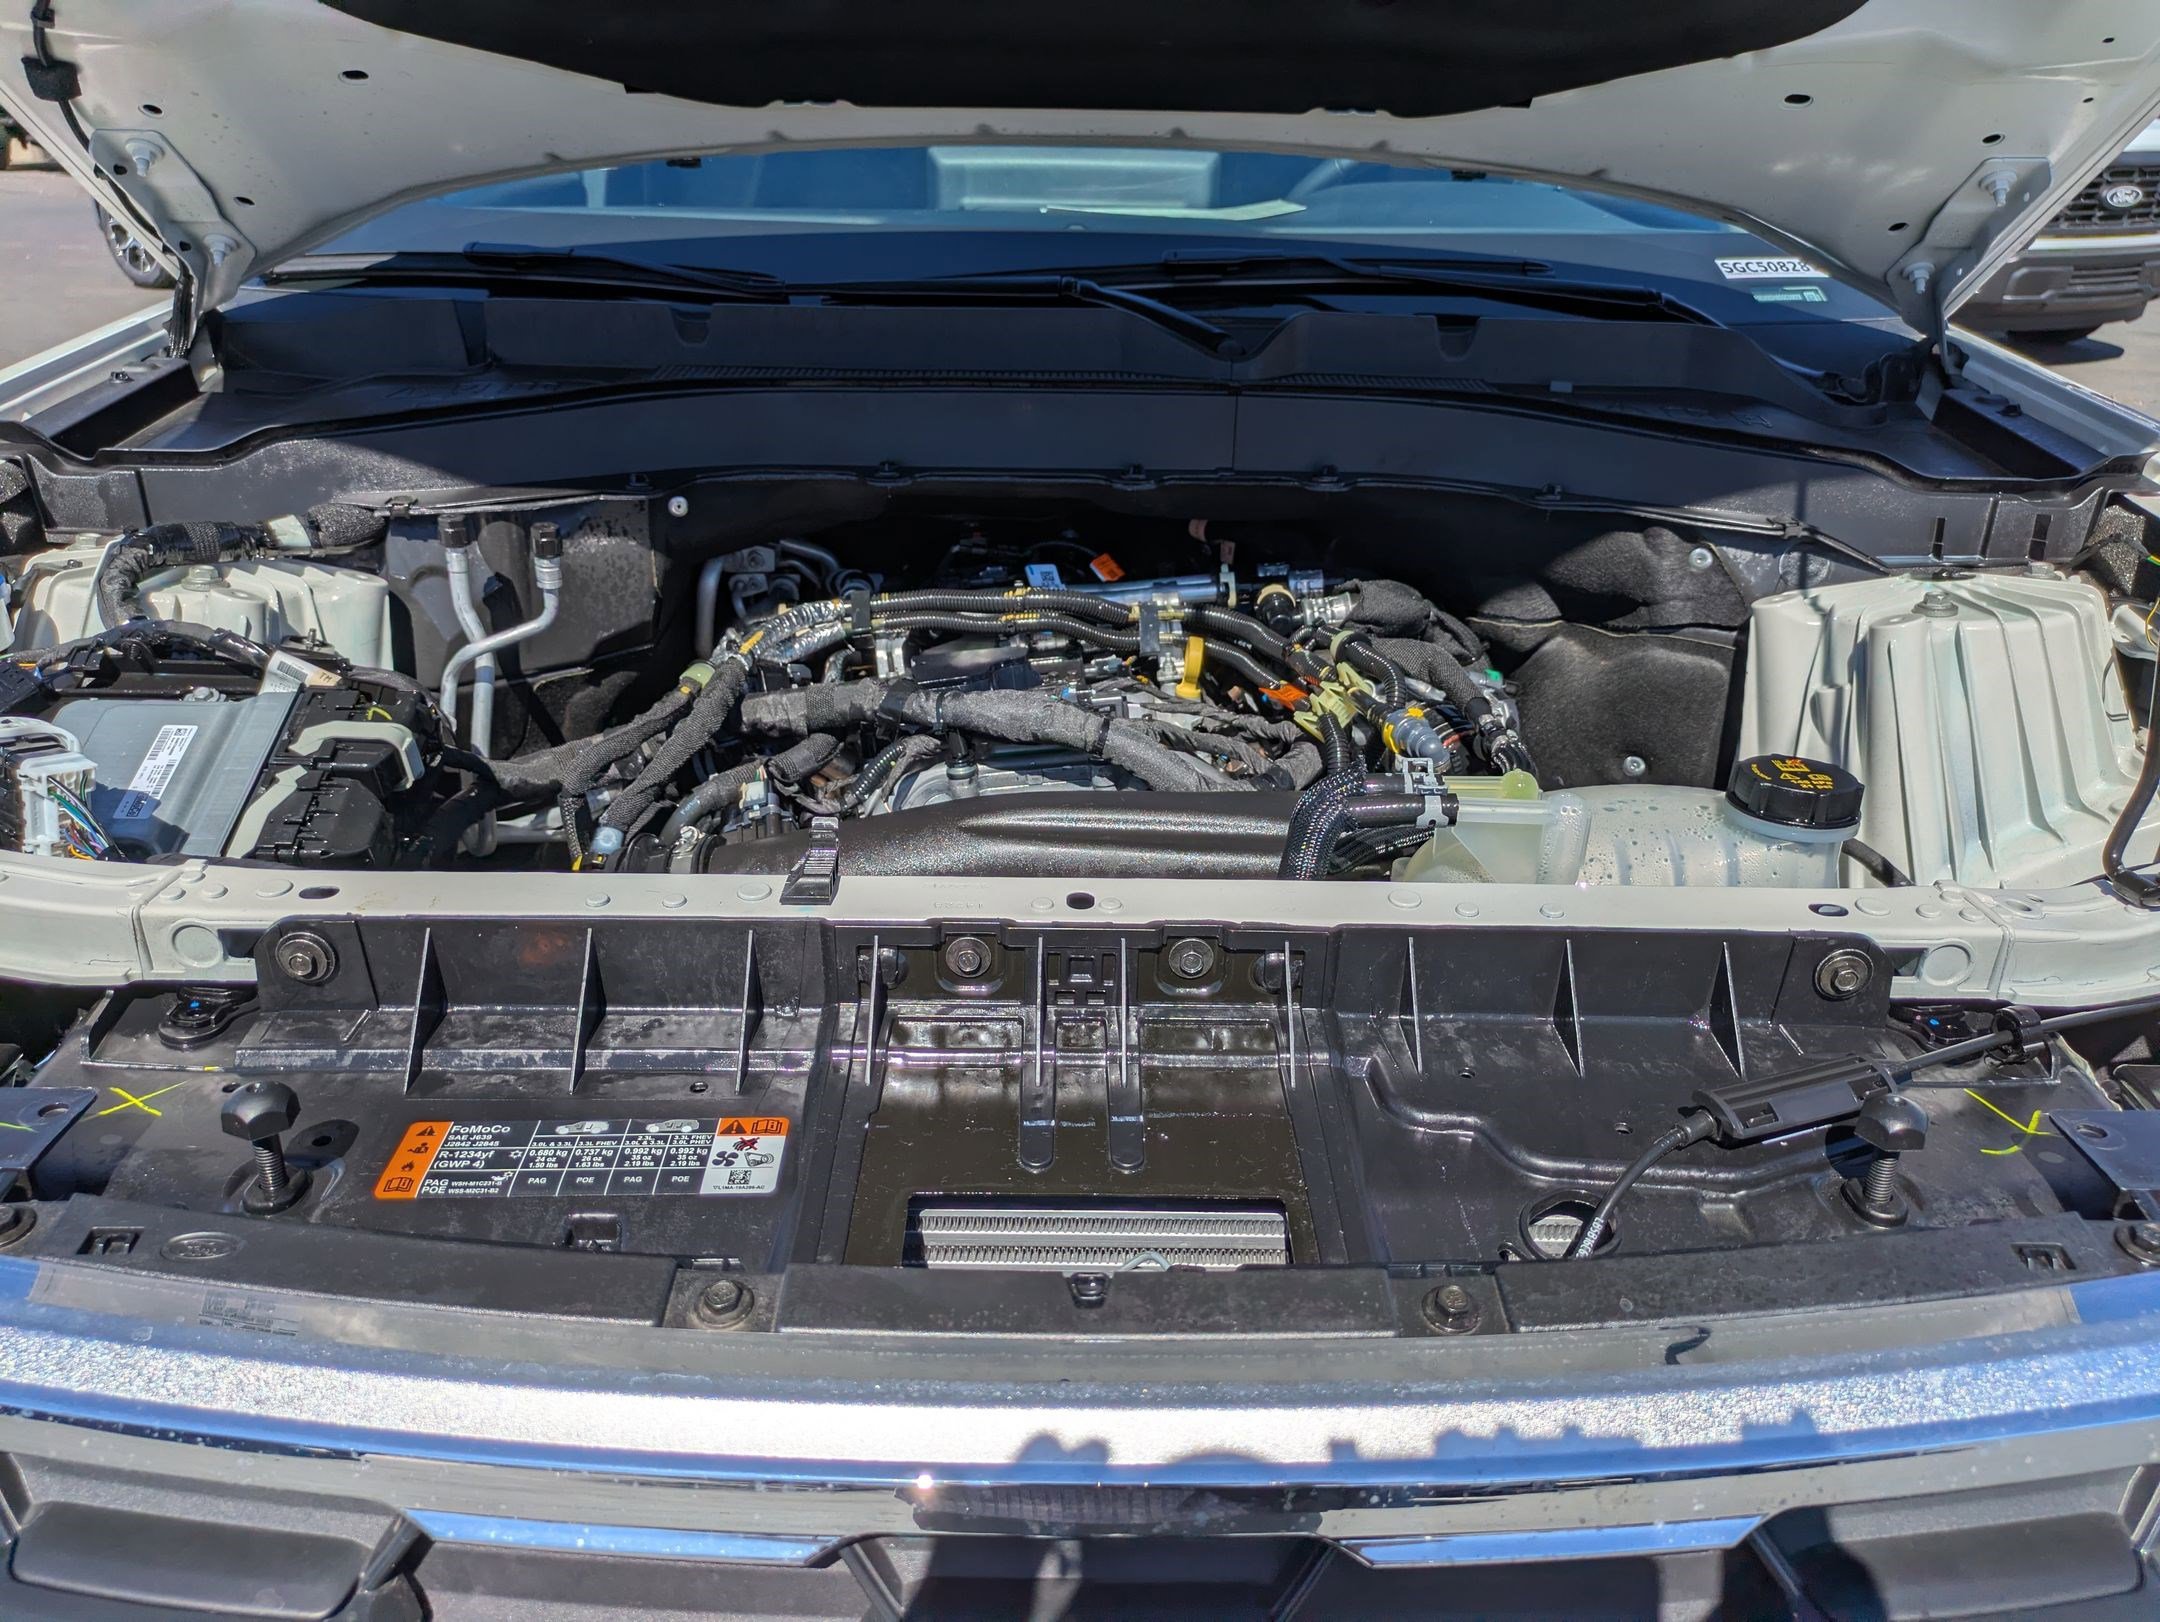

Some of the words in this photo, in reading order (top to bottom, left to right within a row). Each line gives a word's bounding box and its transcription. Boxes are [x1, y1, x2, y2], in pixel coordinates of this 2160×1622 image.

[450, 1124, 511, 1134] FoMoCo
[439, 1150, 496, 1159] R-1234yf
[556, 1149, 568, 1157] kg
[575, 1148, 601, 1156] 0.737
[602, 1148, 614, 1157] kg
[651, 1147, 663, 1155] kg
[696, 1147, 708, 1155] kg
[433, 1160, 471, 1169] (GWP
[472, 1160, 485, 1169] 4)
[576, 1176, 596, 1184] POE
[623, 1175, 643, 1183] PAG
[671, 1175, 691, 1183] POE
[421, 1186, 447, 1194] POE
